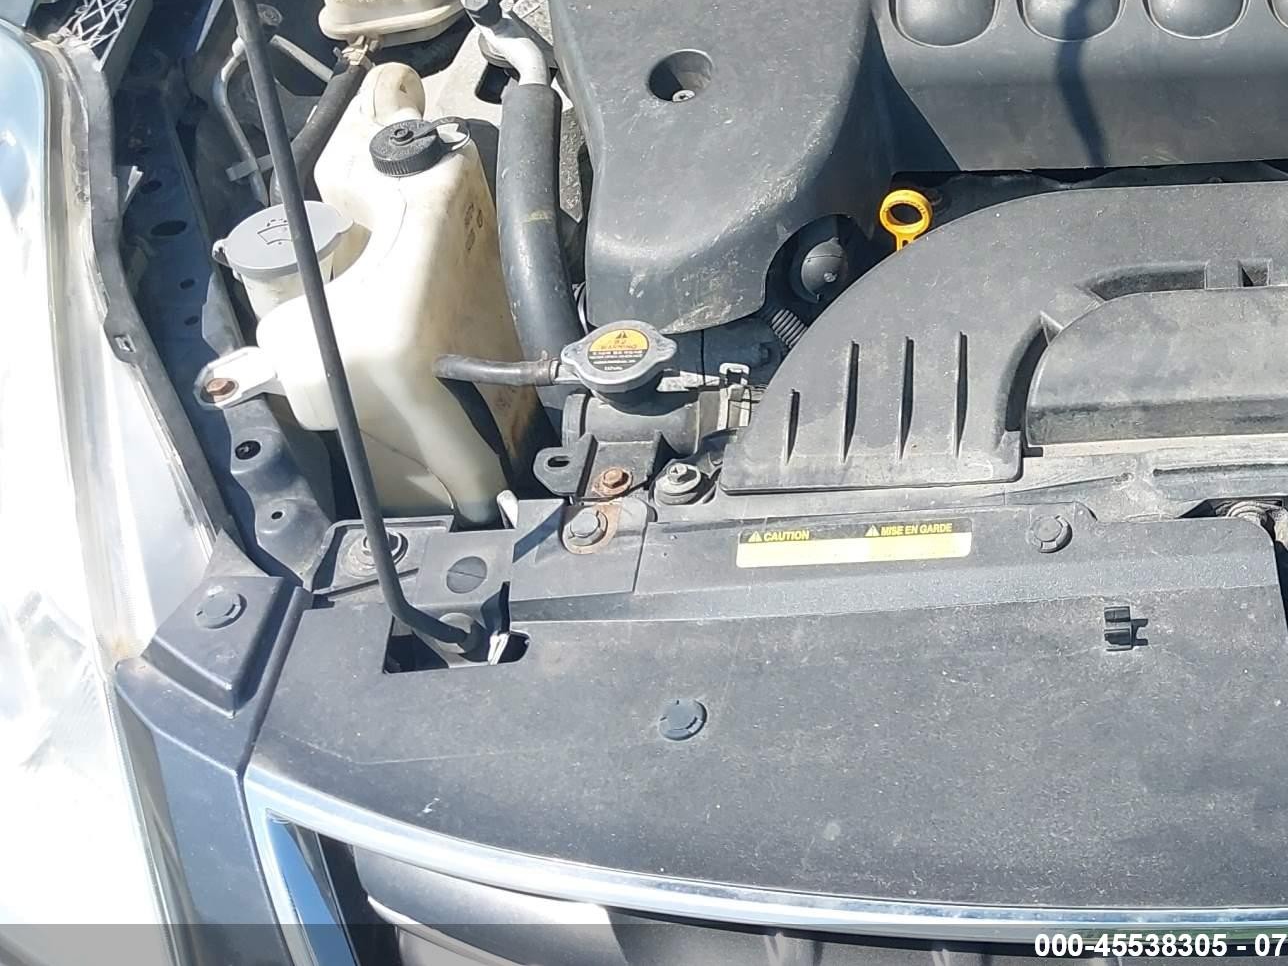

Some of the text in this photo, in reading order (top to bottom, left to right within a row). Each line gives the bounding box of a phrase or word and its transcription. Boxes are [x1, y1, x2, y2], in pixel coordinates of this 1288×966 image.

[880, 523, 952, 535] MISE EN GARDE
[763, 530, 809, 541] CAUTION
